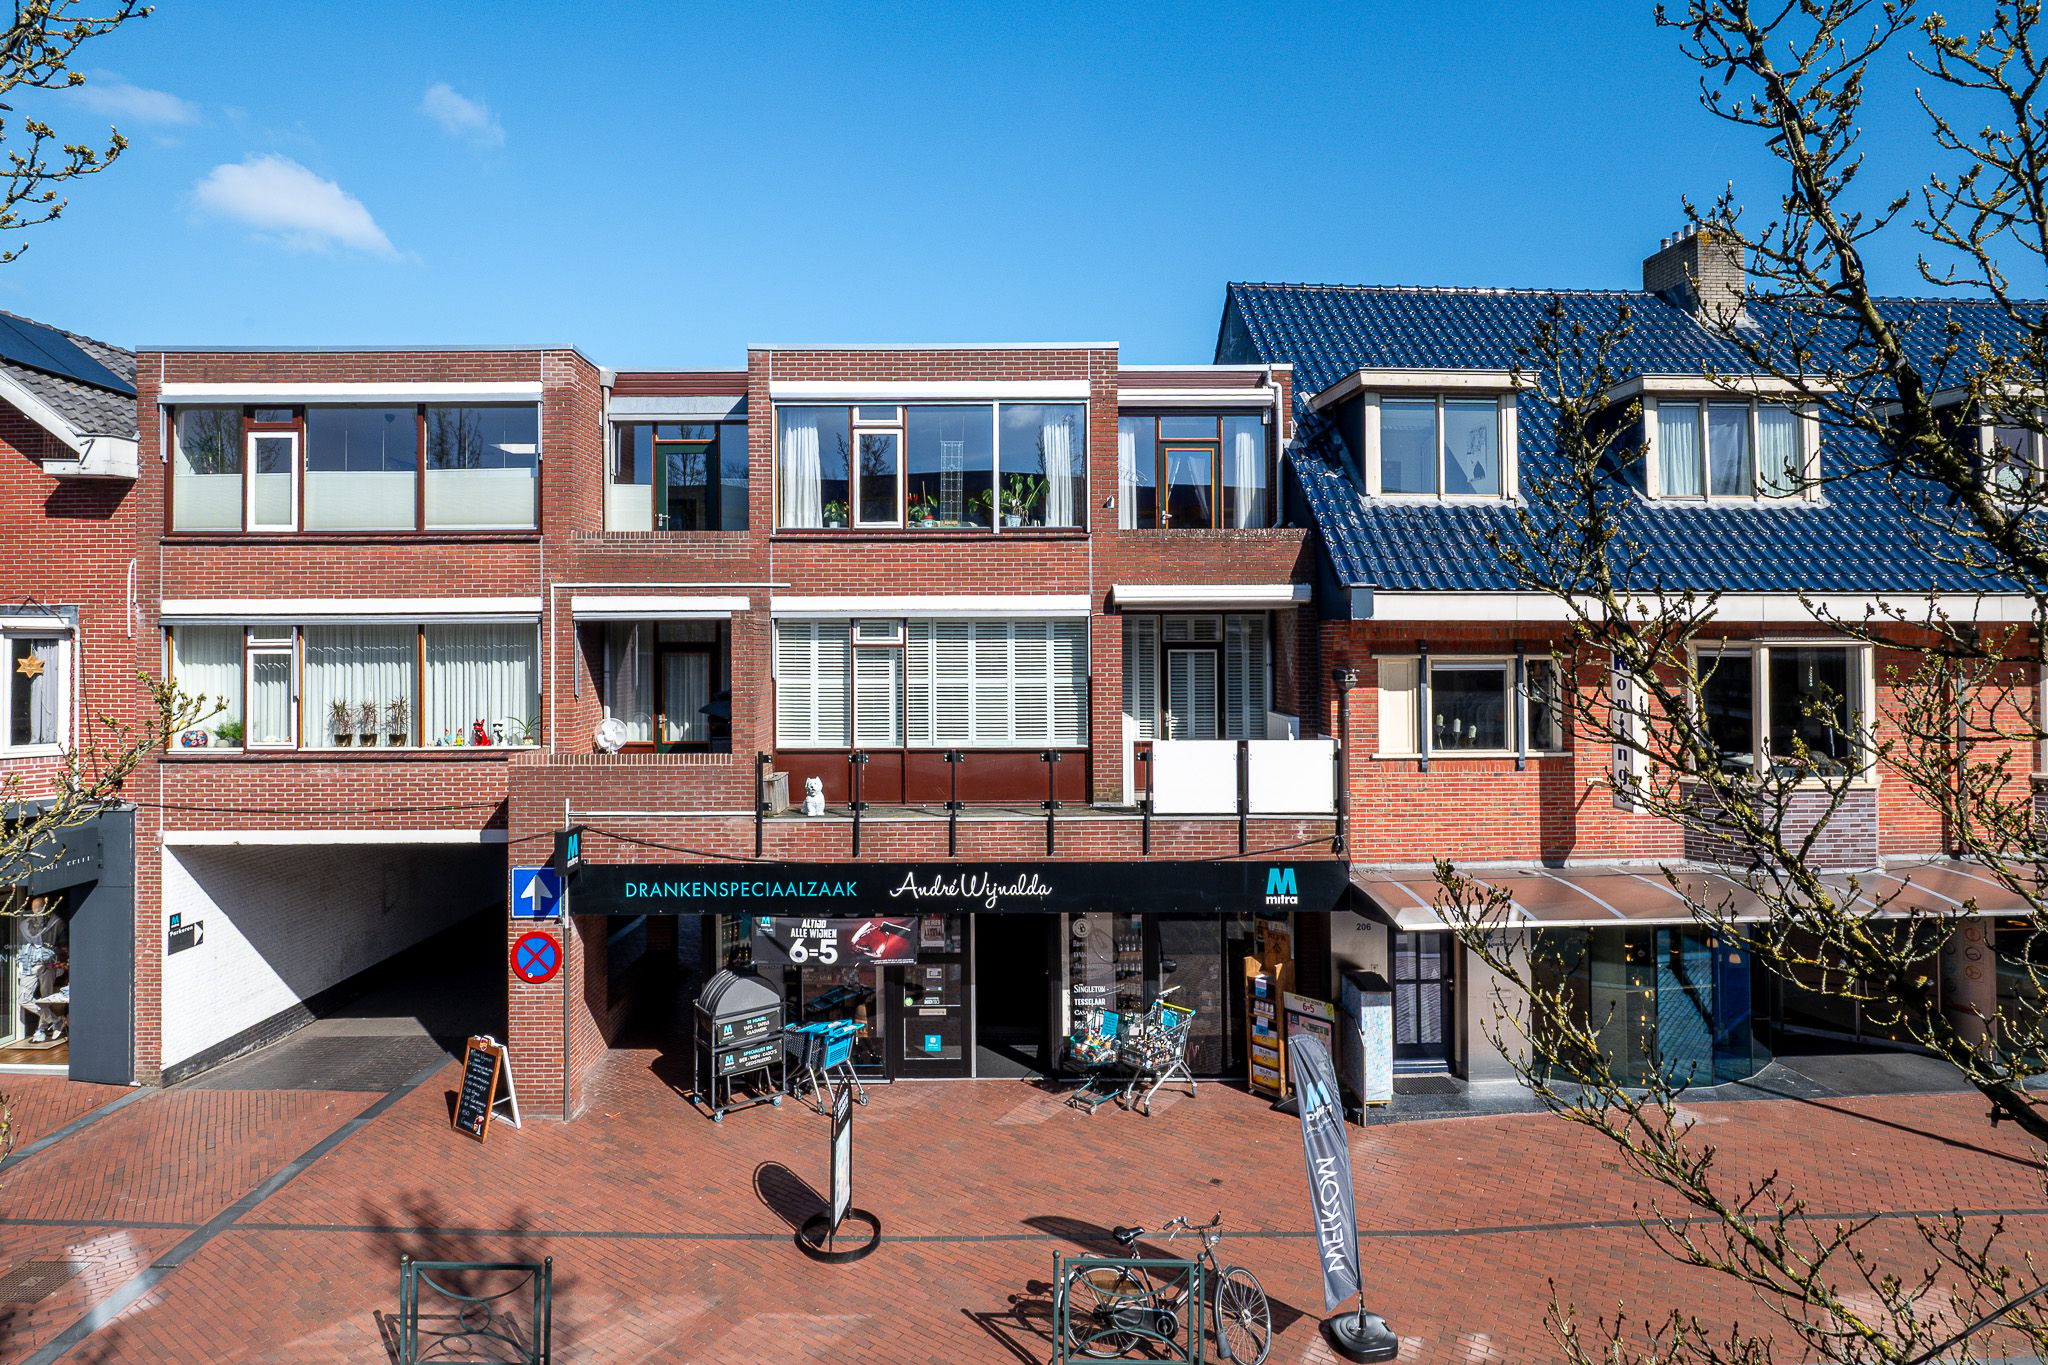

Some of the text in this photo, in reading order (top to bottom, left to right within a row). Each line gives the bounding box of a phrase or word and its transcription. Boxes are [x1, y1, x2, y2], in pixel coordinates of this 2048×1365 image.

[567, 833, 579, 860] M
[1266, 868, 1298, 895] M
[625, 881, 858, 898] DRANKENSPECIAALZAAK
[889, 871, 1053, 909] André Wijnalda
[1265, 894, 1299, 905] mitra
[171, 915, 180, 925] M
[801, 919, 827, 929] ALTIJD
[169, 925, 194, 937] Parkeren
[1356, 923, 1372, 931] 206
[790, 928, 838, 939] ALLE WIJNEN
[788, 938, 839, 965] 6=5
[1074, 998, 1106, 1006] TESSELAAR
